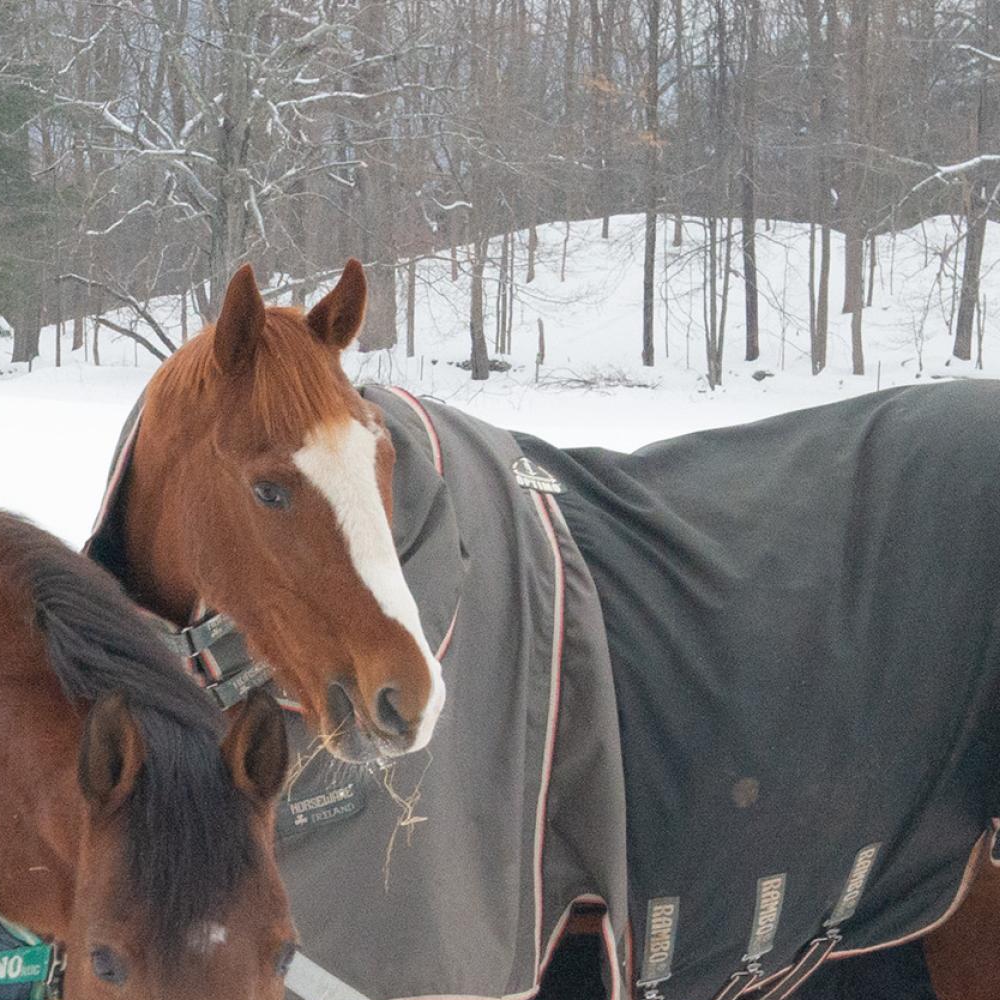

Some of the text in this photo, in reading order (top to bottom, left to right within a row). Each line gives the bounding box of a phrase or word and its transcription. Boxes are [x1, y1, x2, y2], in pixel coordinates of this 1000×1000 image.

[311, 802, 355, 823] IRELAND
[842, 848, 876, 901] RAMBO
[649, 904, 675, 963] RAMBO
[756, 879, 782, 935] RAMBO
